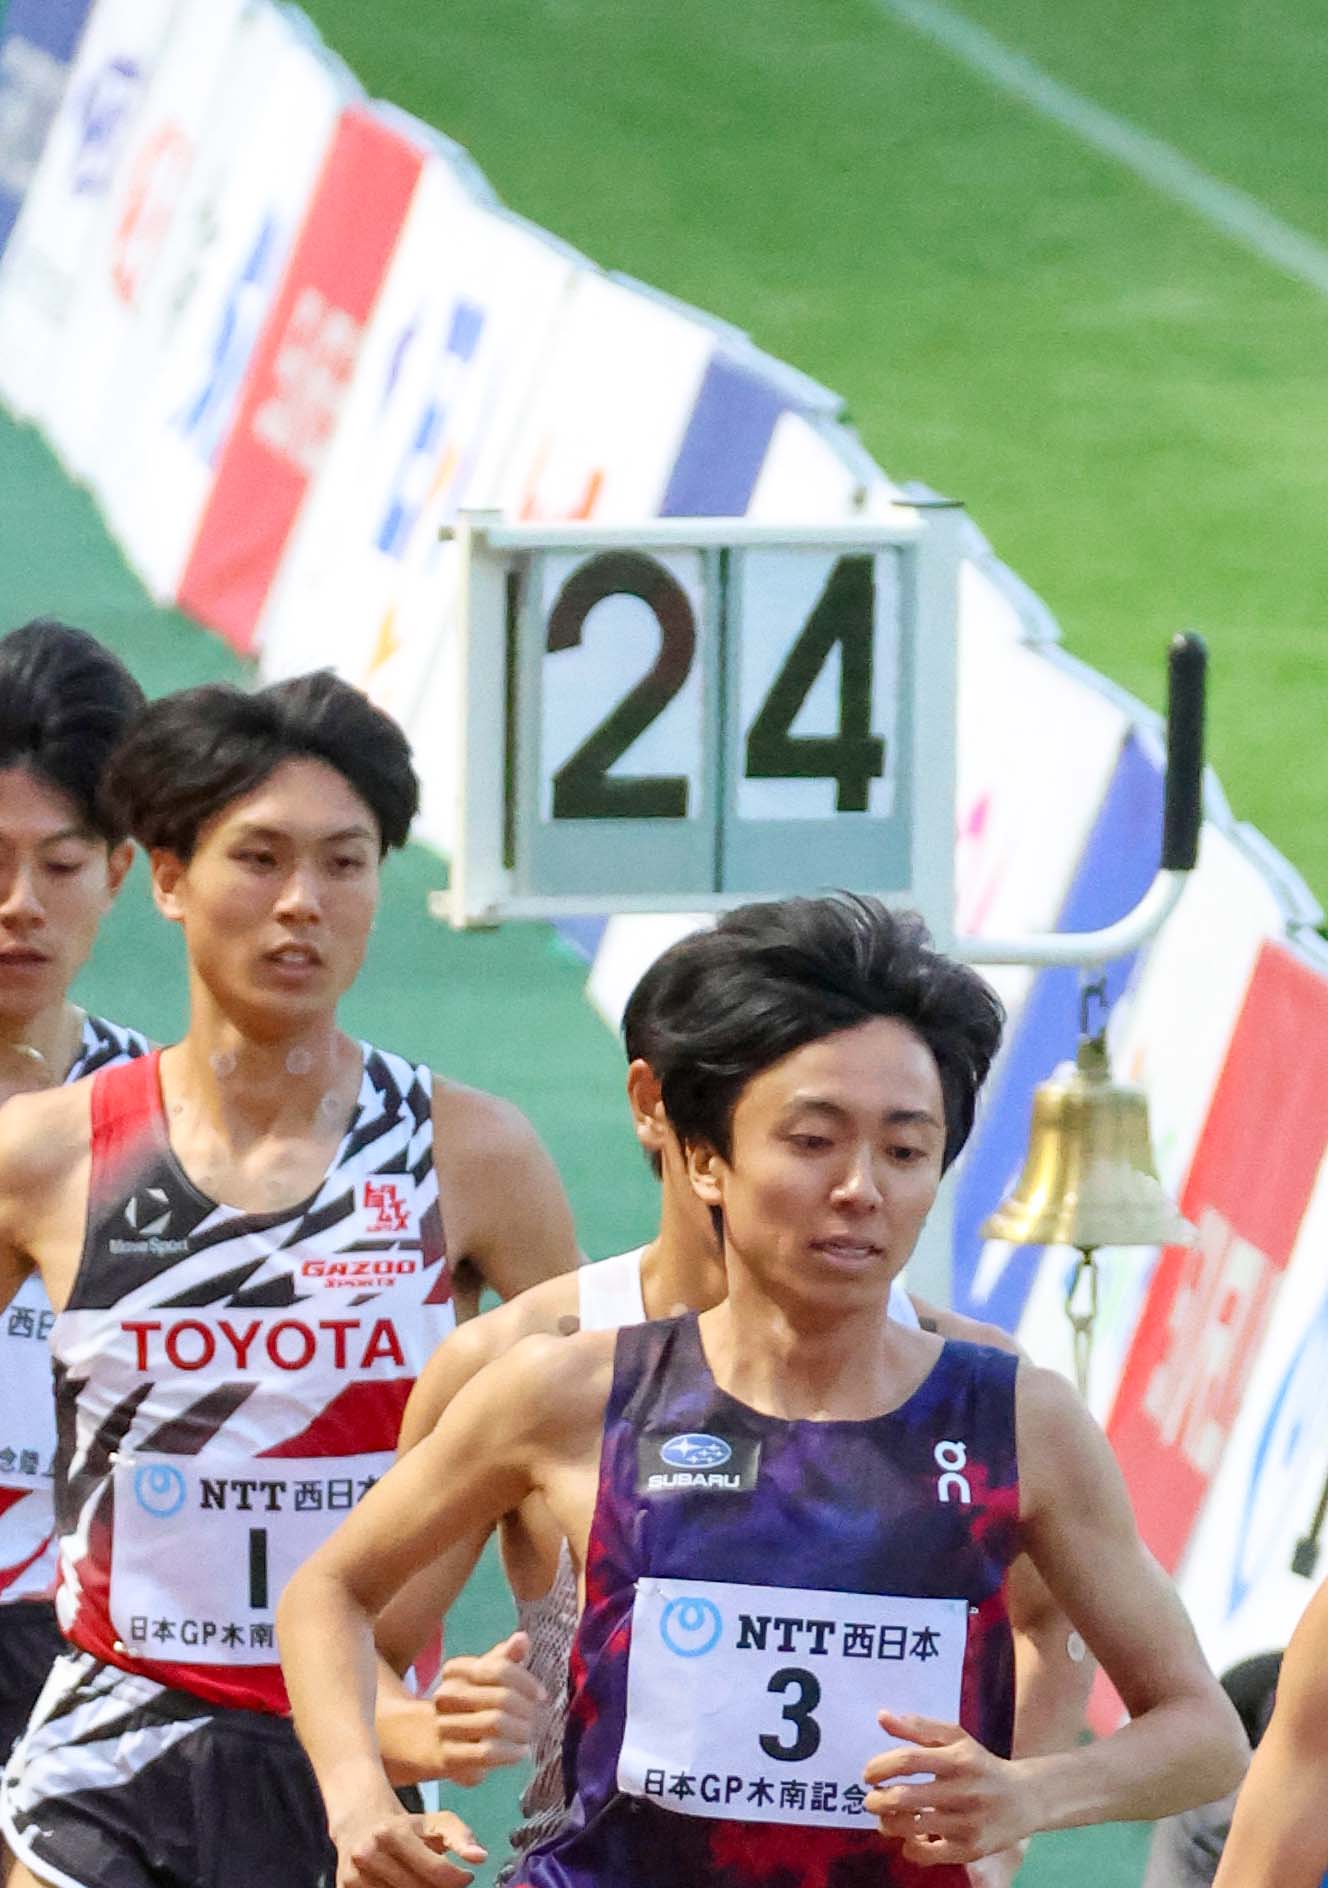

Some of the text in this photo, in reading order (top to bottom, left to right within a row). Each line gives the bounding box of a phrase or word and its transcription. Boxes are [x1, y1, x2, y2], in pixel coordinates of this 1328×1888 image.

[546, 549, 886, 819] 24
[301, 1259, 417, 1276] GAZOO
[121, 1317, 407, 1371] TOYOTA
[200, 1477, 287, 1512] NTT
[648, 1472, 741, 1489] SUBARU
[249, 1527, 269, 1609] 1
[736, 1614, 942, 1662] NTT 西日本
[759, 1666, 822, 1763] 3
